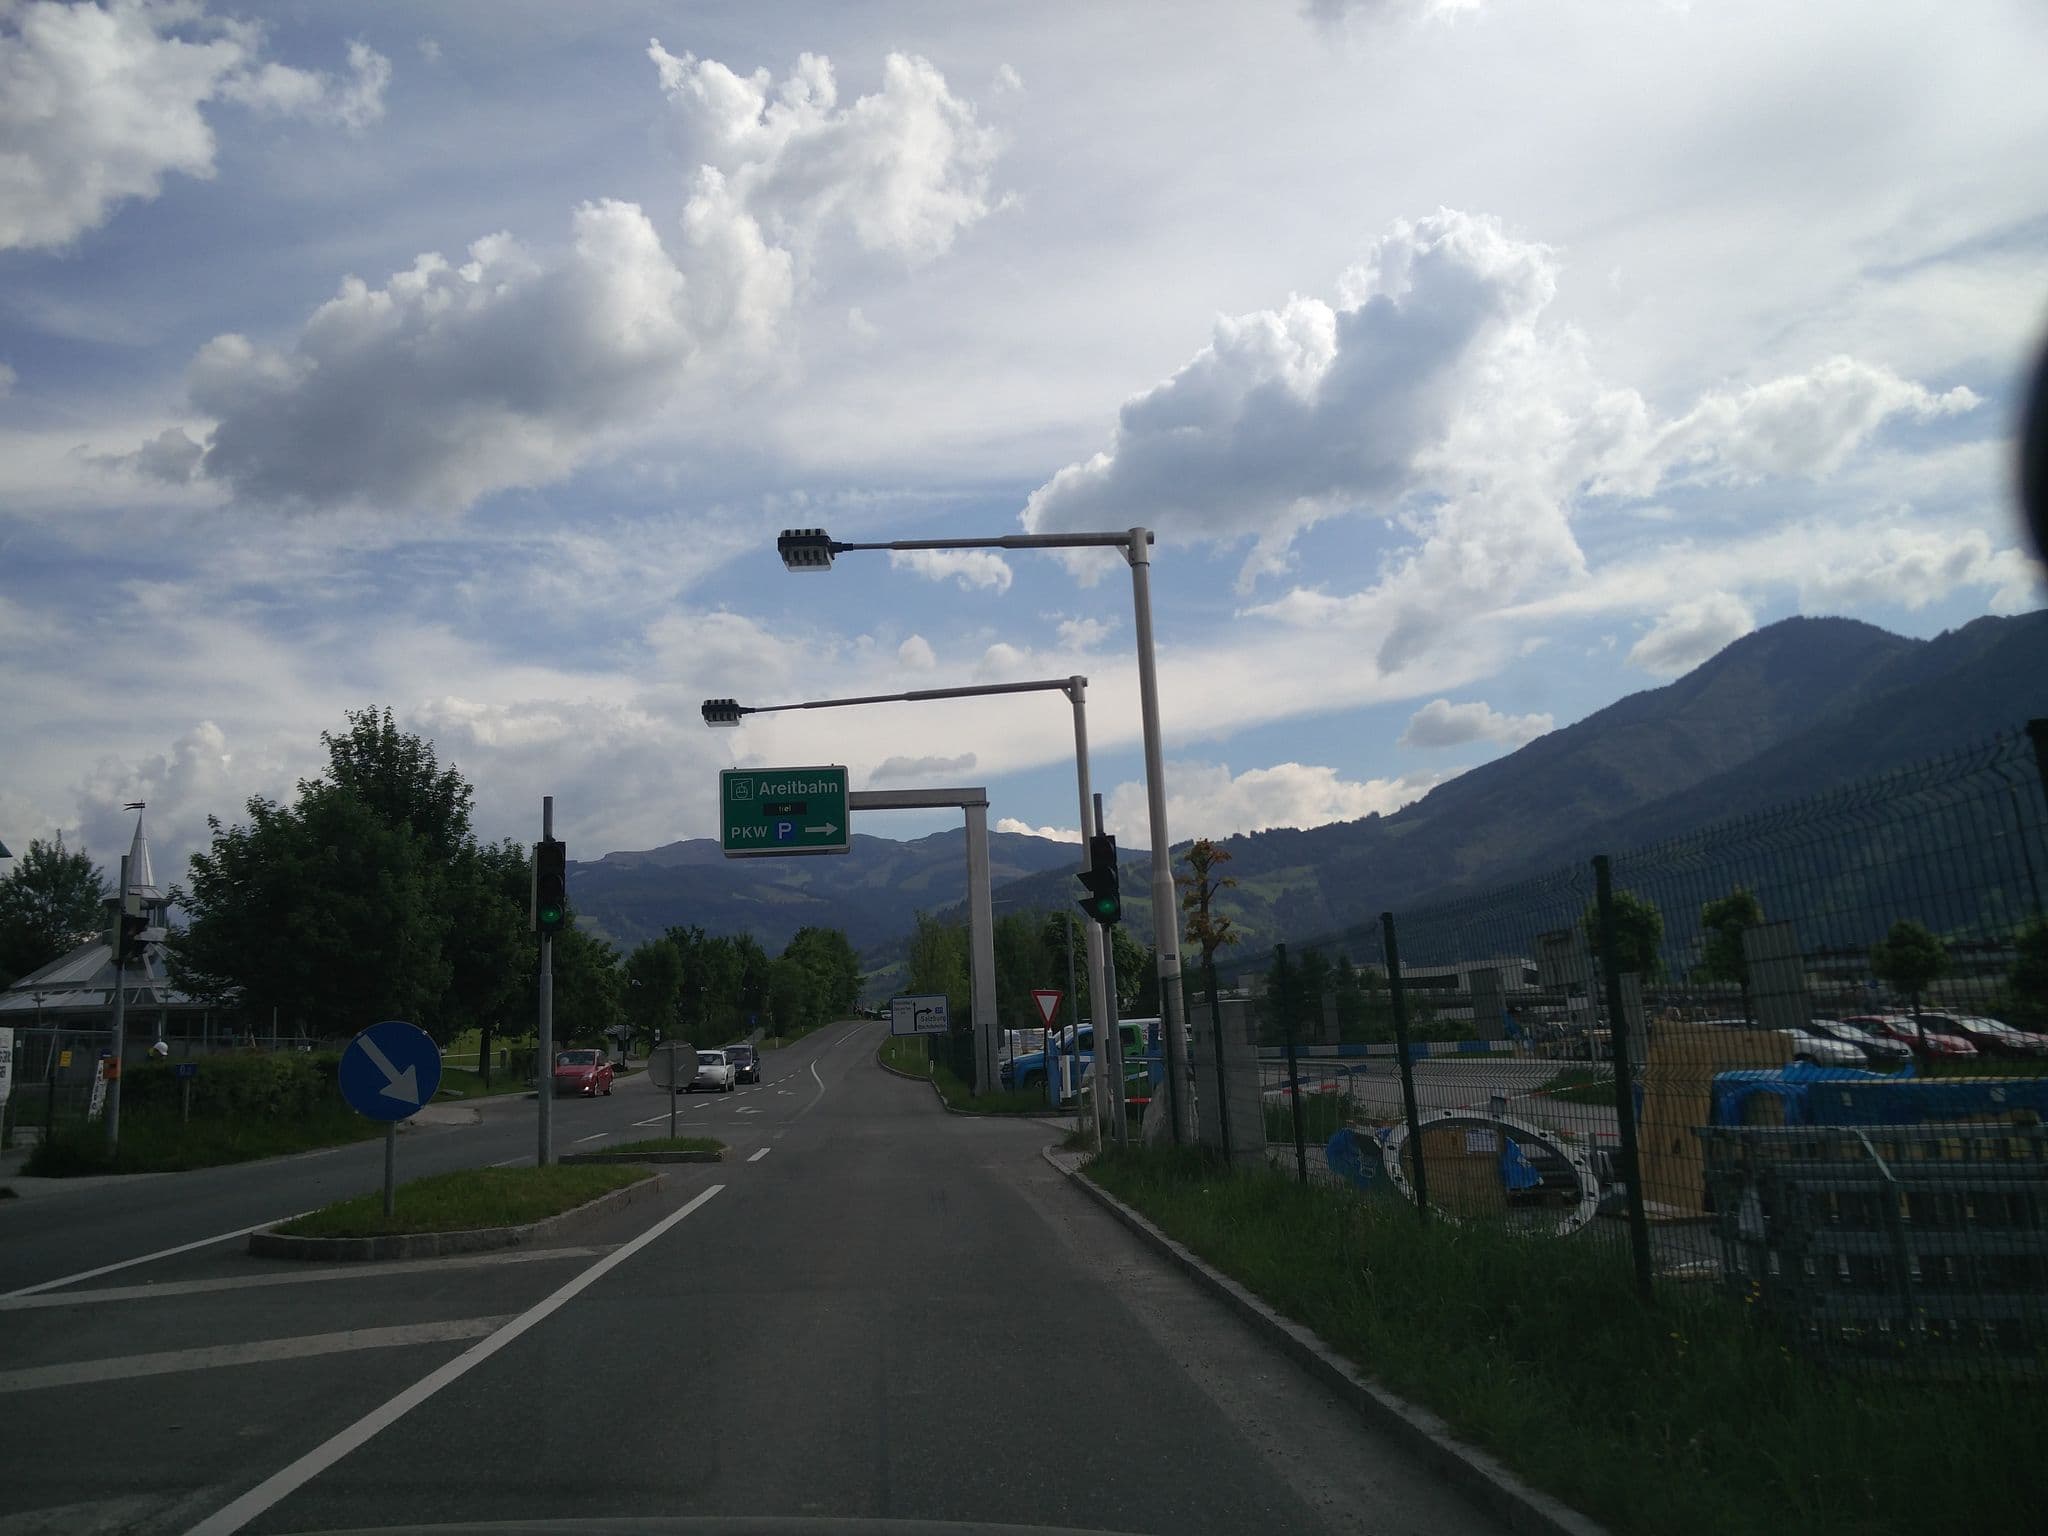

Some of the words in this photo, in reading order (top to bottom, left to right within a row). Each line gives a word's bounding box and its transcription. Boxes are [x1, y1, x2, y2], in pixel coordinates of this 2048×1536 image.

[759, 780, 838, 795] Areitbahn
[731, 826, 768, 839] PKW
[778, 822, 792, 840] P
